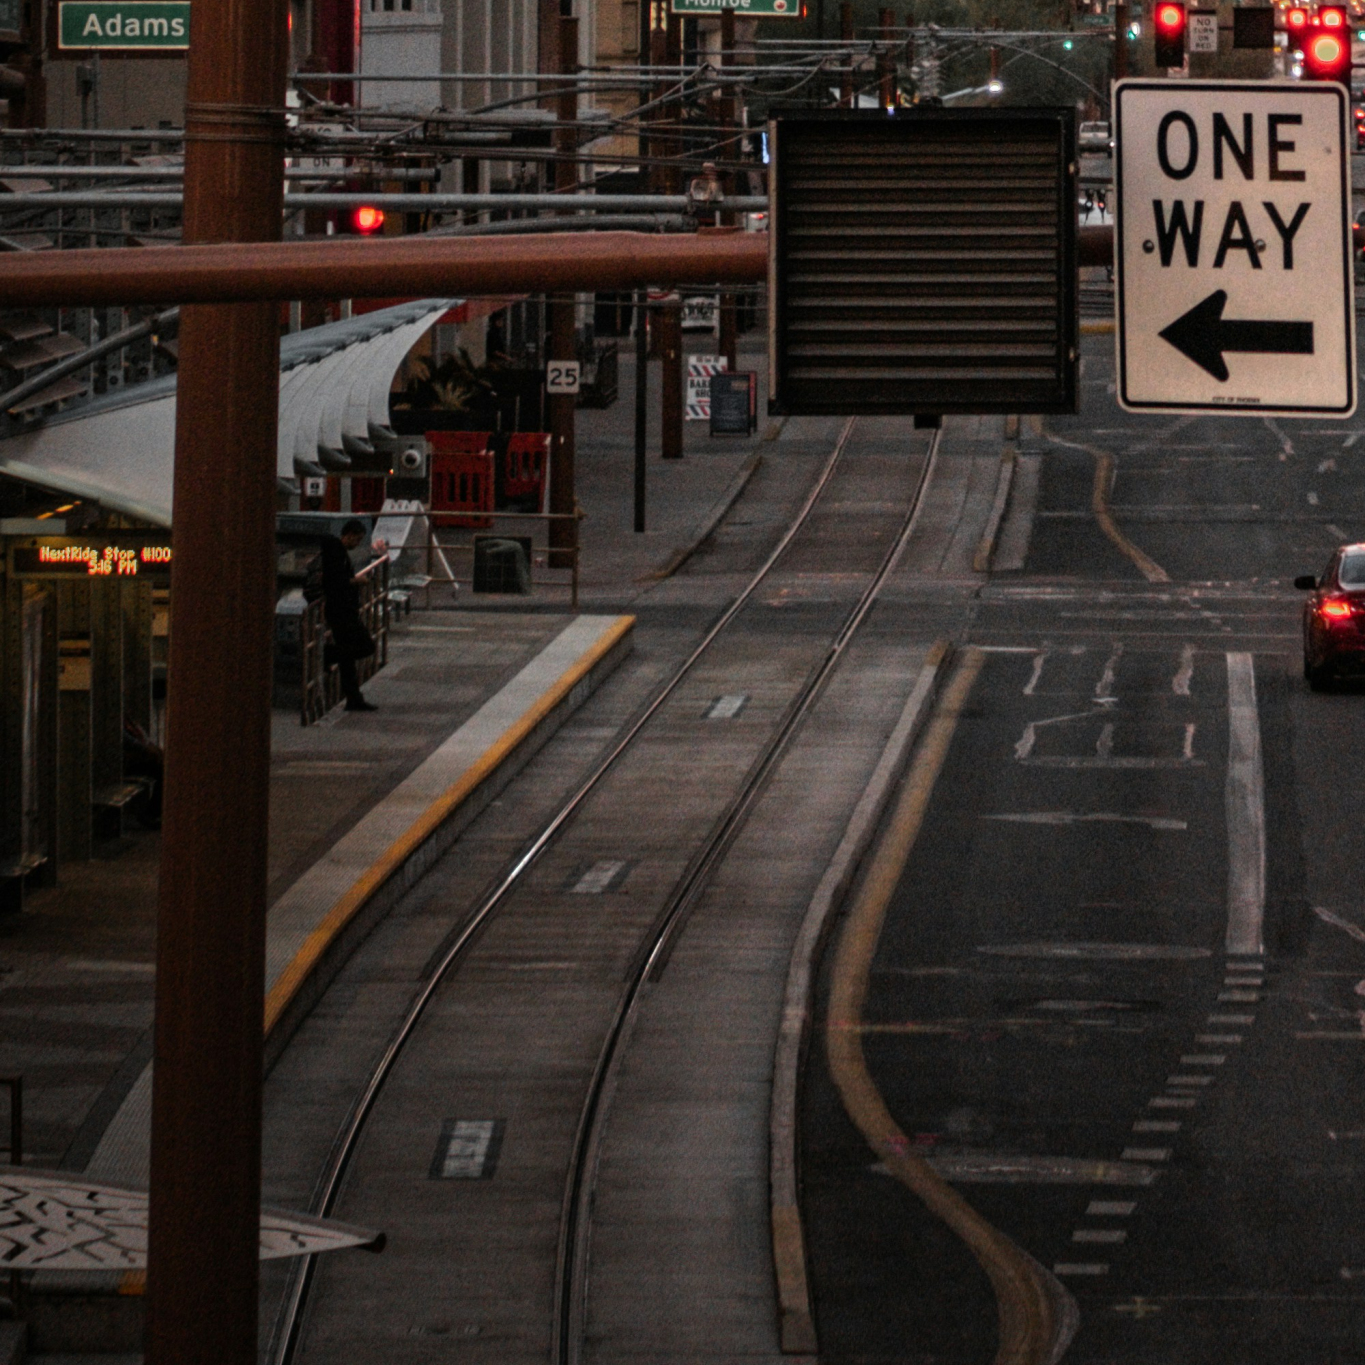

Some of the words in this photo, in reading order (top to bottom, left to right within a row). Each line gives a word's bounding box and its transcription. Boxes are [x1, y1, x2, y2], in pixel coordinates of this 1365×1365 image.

[82, 13, 185, 37] Adams
[1157, 110, 1306, 182] ONE
[1153, 200, 1312, 270] WAY
[550, 368, 577, 386] 25
[103, 545, 135, 561] Stop
[88, 559, 112, 575] 5:16
[117, 559, 137, 575] PM
